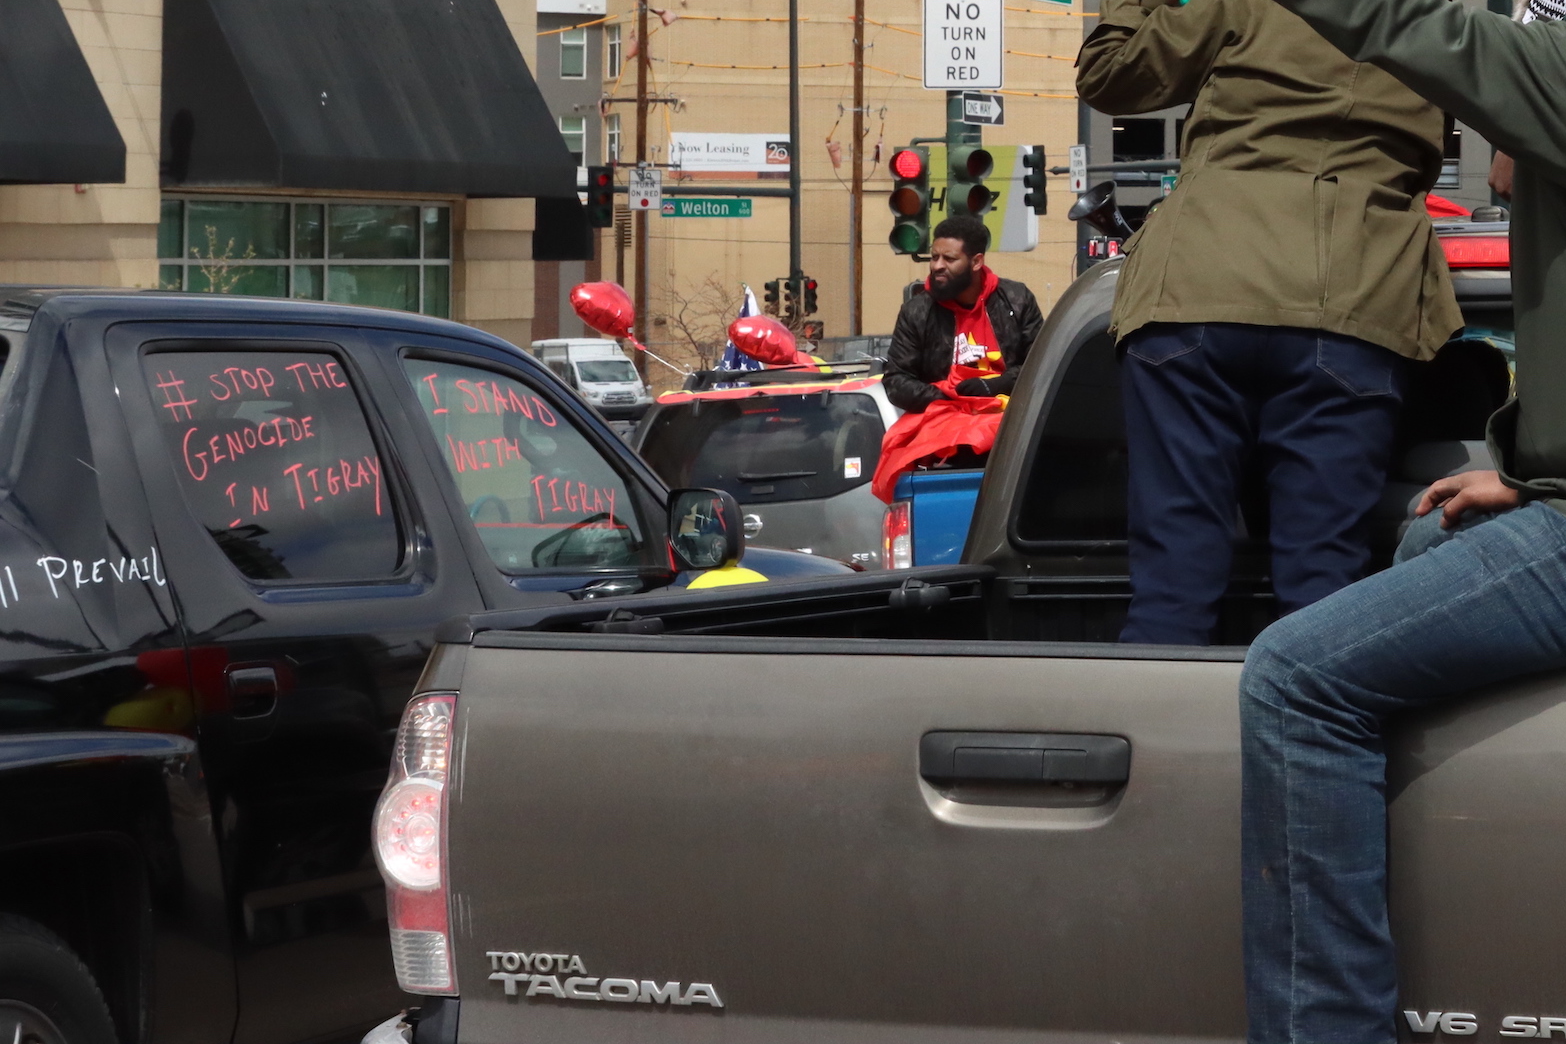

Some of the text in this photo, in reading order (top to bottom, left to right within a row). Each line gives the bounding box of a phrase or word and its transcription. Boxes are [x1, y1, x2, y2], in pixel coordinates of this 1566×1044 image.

[946, 3, 980, 20] NO
[941, 27, 985, 41] TURN
[951, 46, 975, 61] ON
[946, 66, 980, 80] RED
[967, 101, 991, 115] ONE WAY
[678, 142, 750, 156] Now Leasing
[768, 144, 788, 160] 20
[681, 202, 729, 215] Welton
[156, 362, 347, 422] # STOP THE
[422, 373, 557, 427] I STAND
[183, 416, 315, 482] GENOCIDE
[446, 434, 522, 473] WITH
[225, 456, 382, 528] IN TIGRAY
[530, 475, 615, 530] TIGRAY
[36, 546, 166, 599] PREVAIL
[486, 951, 588, 975] TOYOTA
[487, 972, 724, 1008] TACOMA
[1403, 1010, 1478, 1036] V6
